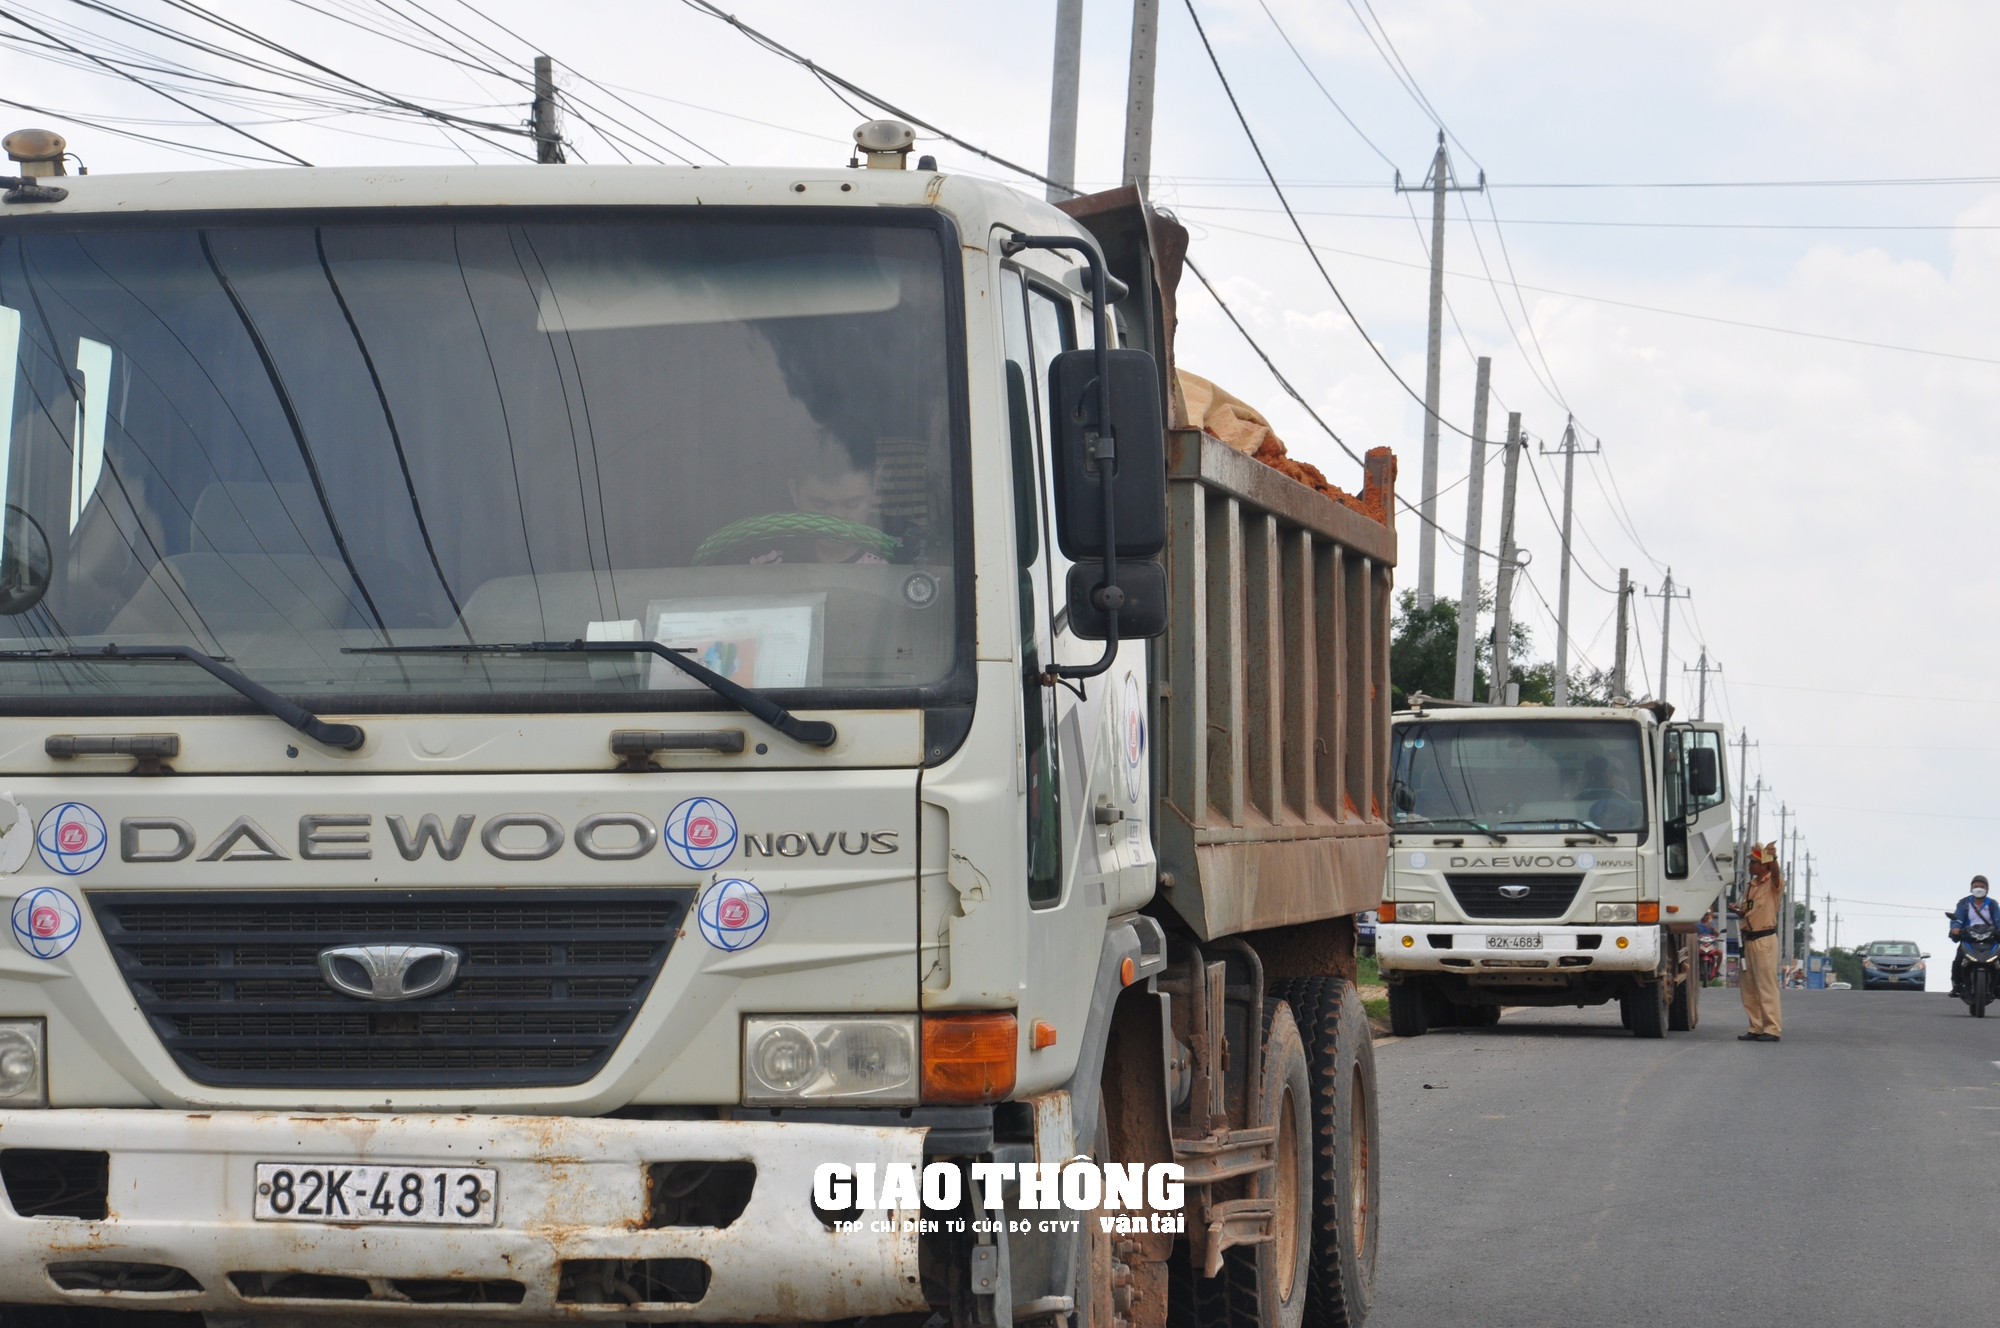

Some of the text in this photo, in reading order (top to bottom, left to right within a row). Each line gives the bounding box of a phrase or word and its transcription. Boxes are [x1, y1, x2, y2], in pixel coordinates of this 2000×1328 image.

[120, 812, 658, 863] DAEWOO
[744, 830, 899, 857] NOVUS
[1450, 855, 1576, 868] DAEWOO
[1490, 937, 1540, 948] 82K-4683
[270, 1169, 482, 1218] 82K-4813
